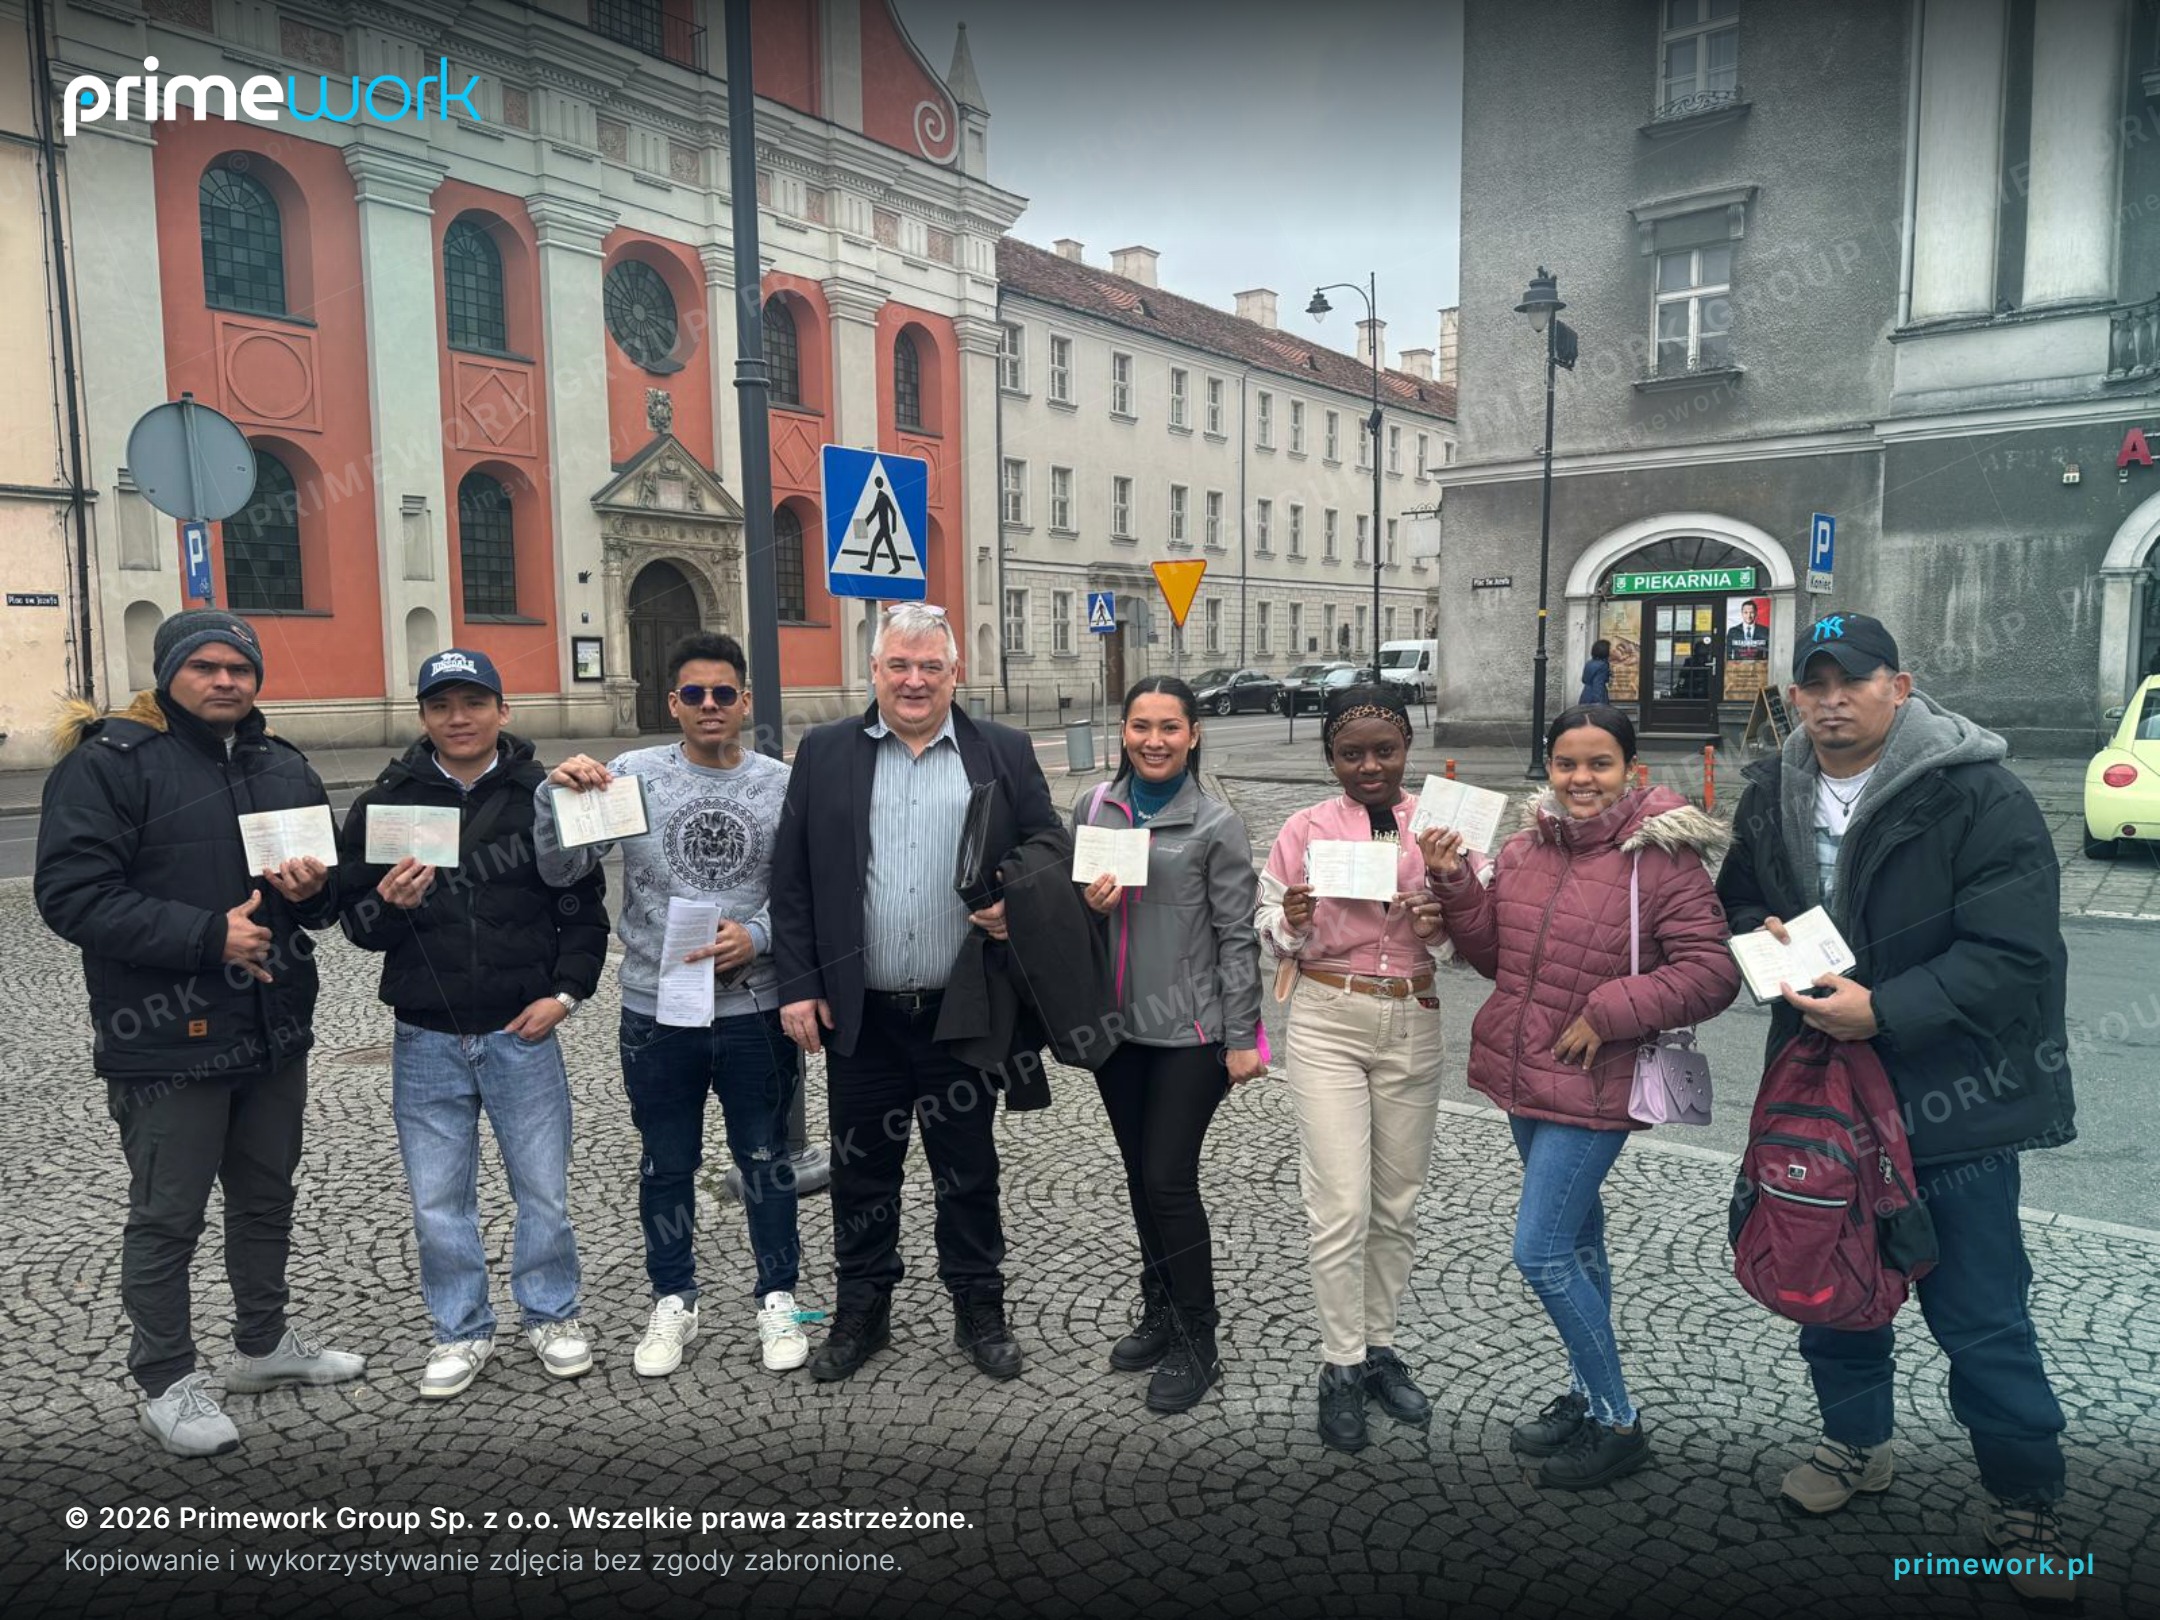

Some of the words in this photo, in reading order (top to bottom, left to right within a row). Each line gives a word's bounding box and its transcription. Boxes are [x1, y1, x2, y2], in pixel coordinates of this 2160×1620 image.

[187, 529, 204, 577] P
[1815, 520, 1832, 564] P
[1634, 573, 1732, 590] PIEKARNIA
